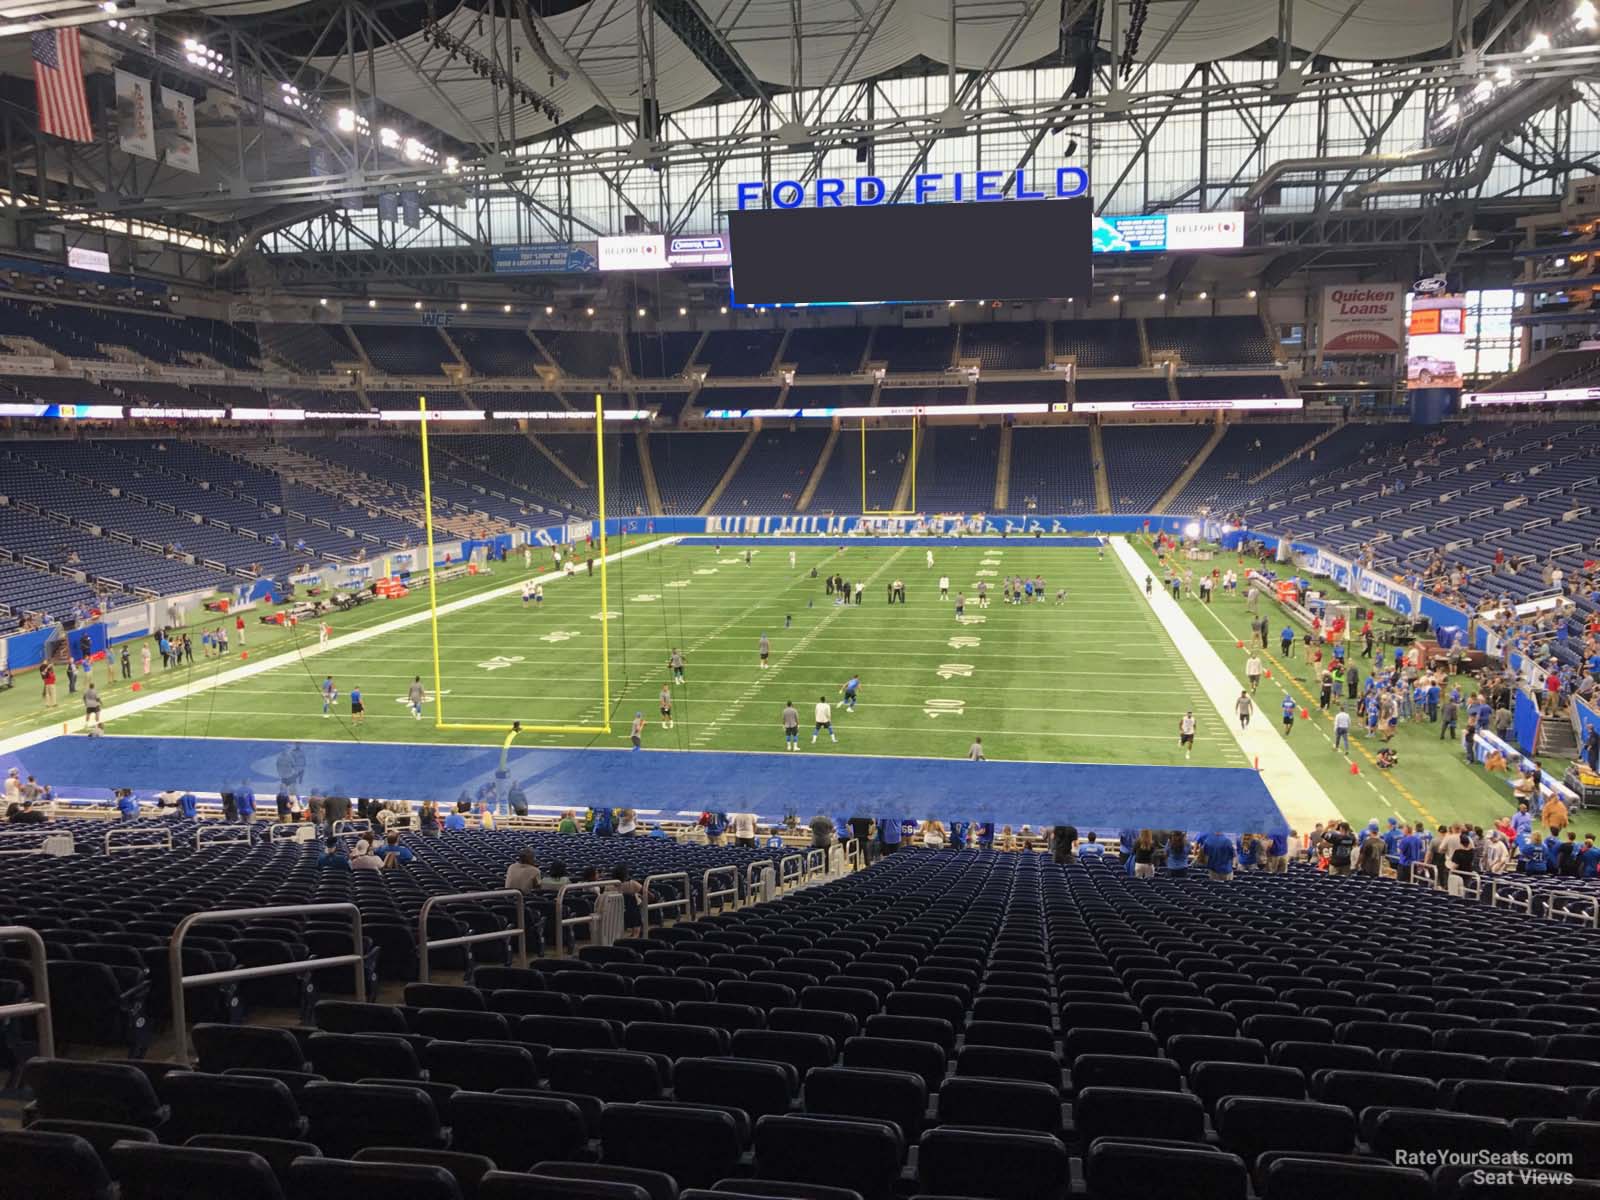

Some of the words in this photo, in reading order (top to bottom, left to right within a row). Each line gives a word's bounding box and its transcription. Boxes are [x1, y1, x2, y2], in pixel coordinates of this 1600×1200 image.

[737, 176, 886, 209] FORD
[914, 166, 1090, 204] FIELD
[1331, 289, 1395, 302] Quicken
[1340, 303, 1388, 315] Loans
